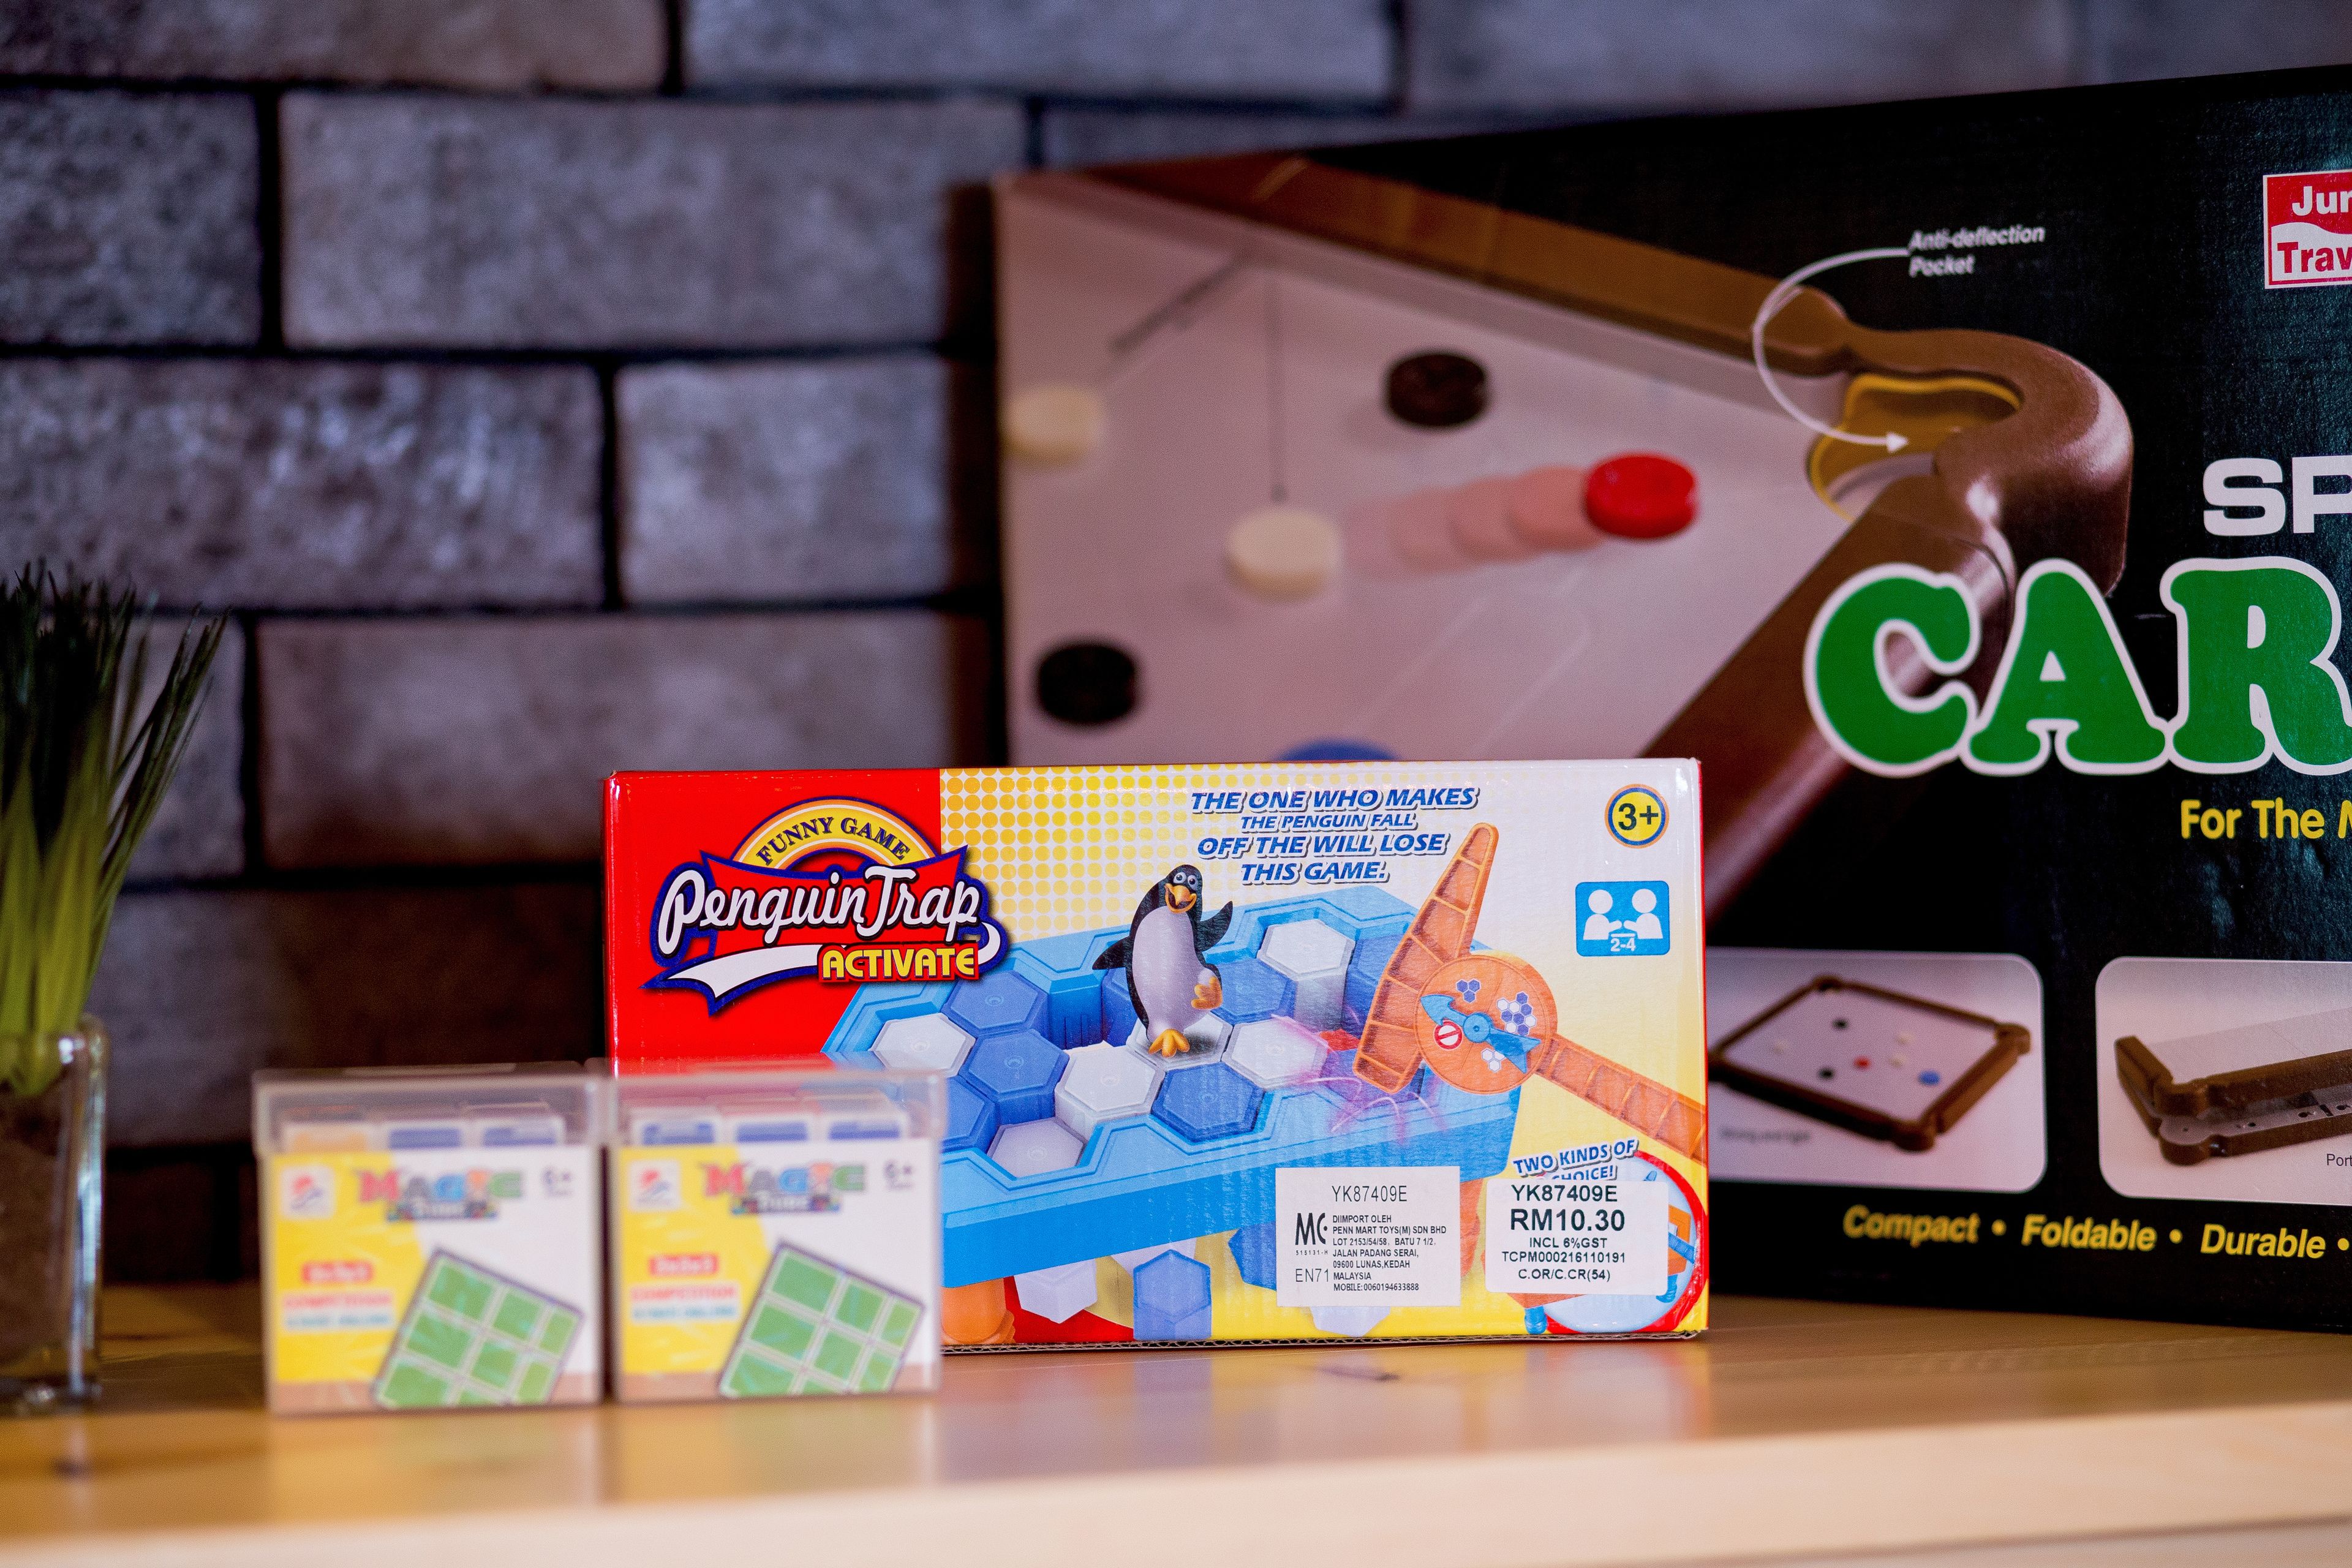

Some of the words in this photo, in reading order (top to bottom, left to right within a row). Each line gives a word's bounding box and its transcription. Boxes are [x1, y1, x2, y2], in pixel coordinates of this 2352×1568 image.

[1909, 224, 2046, 251] Anti-deflection
[1909, 254, 1975, 277] Pocket
[2277, 242, 2352, 273] Trav
[2203, 455, 2352, 537] SP
[1803, 556, 2352, 777] CAR
[1191, 791, 1242, 810] THE
[1248, 790, 1306, 809] ONE
[1313, 790, 1379, 807] WHO
[1384, 788, 1475, 806] MAKES
[1241, 816, 1278, 829] THE
[1281, 815, 1366, 829] PENGUIN
[1370, 813, 1413, 827] FALL
[1618, 803, 1659, 831] 3+
[2180, 799, 2242, 840] For
[2251, 796, 2325, 839] The
[756, 816, 834, 866] FUNNY
[840, 817, 911, 861] GAME
[1197, 837, 1249, 856] OFF
[1256, 836, 1306, 854] THE
[1313, 835, 1373, 853] WILL
[1379, 834, 1446, 852] LOSE
[1242, 862, 1297, 881] THIS
[658, 869, 865, 955] Penguin
[856, 865, 980, 942] Trap
[1610, 938, 1637, 952] 2-4
[822, 947, 975, 979] ACTIVATE
[1513, 1154, 1554, 1175] TWO
[1559, 1144, 1608, 1166] KINDS
[1613, 1139, 1635, 1156] OF
[1332, 1185, 1408, 1202] YK87409E
[1511, 1185, 1618, 1202] YK87409E
[1371, 1215, 1392, 1223] OLEH
[1510, 1208, 1626, 1232] RM10.30
[1379, 1226, 1411, 1236] TOYS(M)
[1842, 1204, 1980, 1248] Compact
[2021, 1213, 2158, 1251] Foldable
[2200, 1224, 2327, 1259] Durable
[1332, 1249, 1358, 1257] JALAN
[1360, 1249, 1392, 1257] PADANG
[1393, 1249, 1419, 1258] SERAI,
[1529, 1237, 1559, 1248] INCL
[1563, 1237, 1608, 1249] 6%GST
[1355, 1260, 1411, 1270] LUNAS,KEDAH
[1502, 1251, 1626, 1264] TCPM000216110191
[1295, 1268, 1329, 1283] EN71
[1518, 1268, 1611, 1282] C.OR/C.CR(54)
